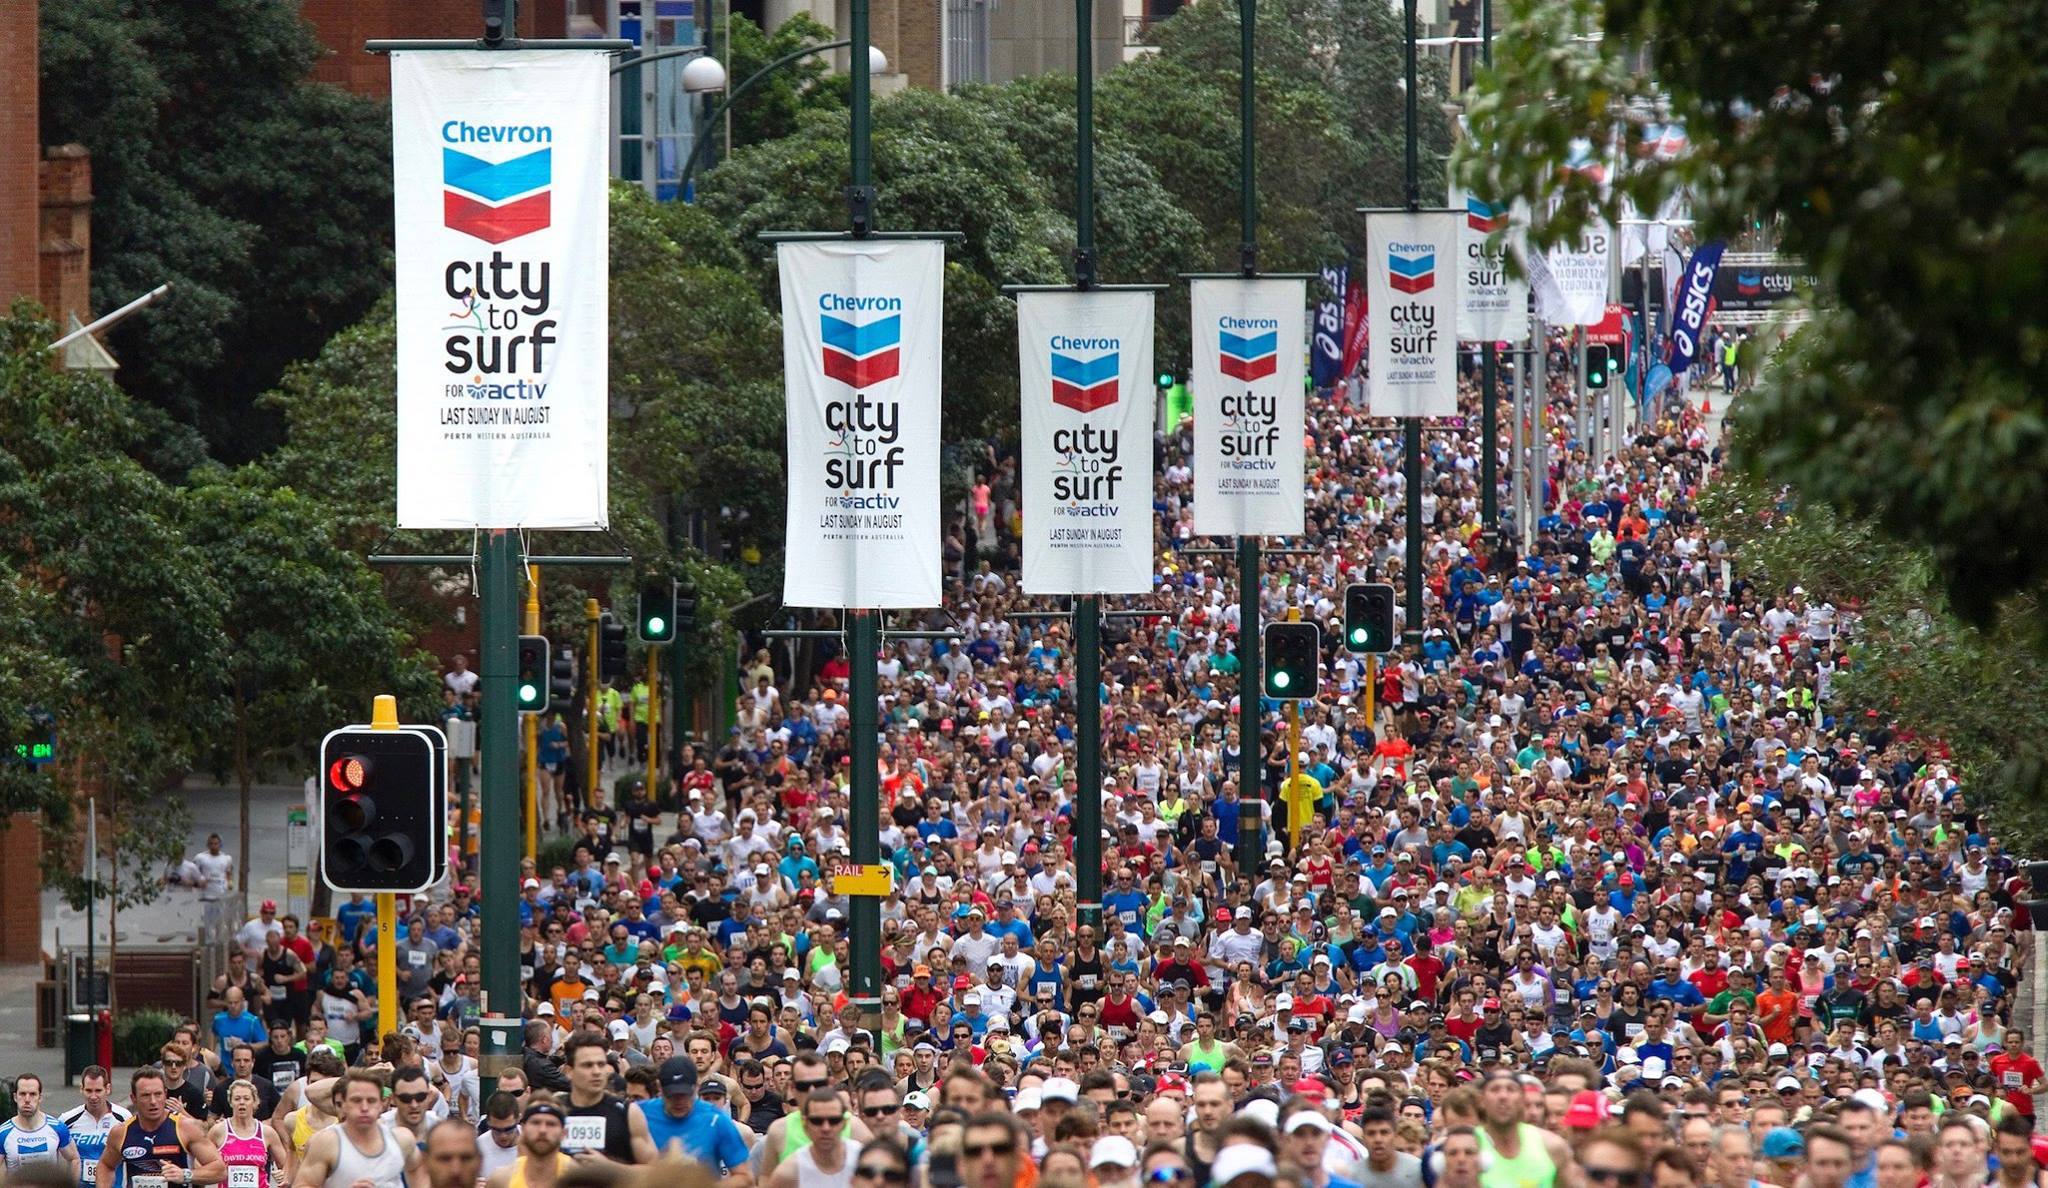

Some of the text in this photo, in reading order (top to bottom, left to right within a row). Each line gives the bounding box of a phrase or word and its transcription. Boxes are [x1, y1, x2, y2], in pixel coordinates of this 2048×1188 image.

[442, 120, 552, 142] Chevron
[1388, 242, 1435, 253] Chevron
[445, 251, 550, 316] city
[1763, 273, 1793, 292] city
[819, 293, 901, 311] Chevron
[1681, 262, 1714, 329] asics
[488, 304, 518, 330] to
[1219, 316, 1278, 329] Chevron
[1390, 301, 1434, 329] city
[1409, 324, 1422, 336] to
[445, 319, 557, 374] surf
[1051, 335, 1119, 350] Chevron
[1390, 330, 1437, 354] surf
[1409, 355, 1435, 365] activ
[445, 379, 547, 399] FOR activ
[440, 406, 550, 425] LAST SUNDAY IN AUGUST
[1220, 390, 1276, 425] city
[825, 394, 899, 444] city
[1244, 421, 1260, 433] to
[853, 435, 876, 455] to
[1053, 423, 1118, 464] city
[1220, 427, 1279, 456] surf
[825, 447, 904, 489] surf
[1081, 456, 1099, 473] to
[1243, 458, 1276, 470] activ
[1053, 466, 1123, 500] surf
[1218, 479, 1232, 489] LAST
[1258, 479, 1280, 489] AUGUST
[825, 493, 900, 509] FOR activ
[1053, 503, 1119, 517] FOR activ
[820, 515, 902, 528] LAST SUNDAY IN AUGUST
[1050, 529, 1122, 540] LAST SUNDAY IN AUGUST
[834, 864, 863, 877] RAIL
[382, 923, 388, 932] 5
[17, 1136, 47, 1144] Chevron
[233, 1172, 254, 1183] 8752
